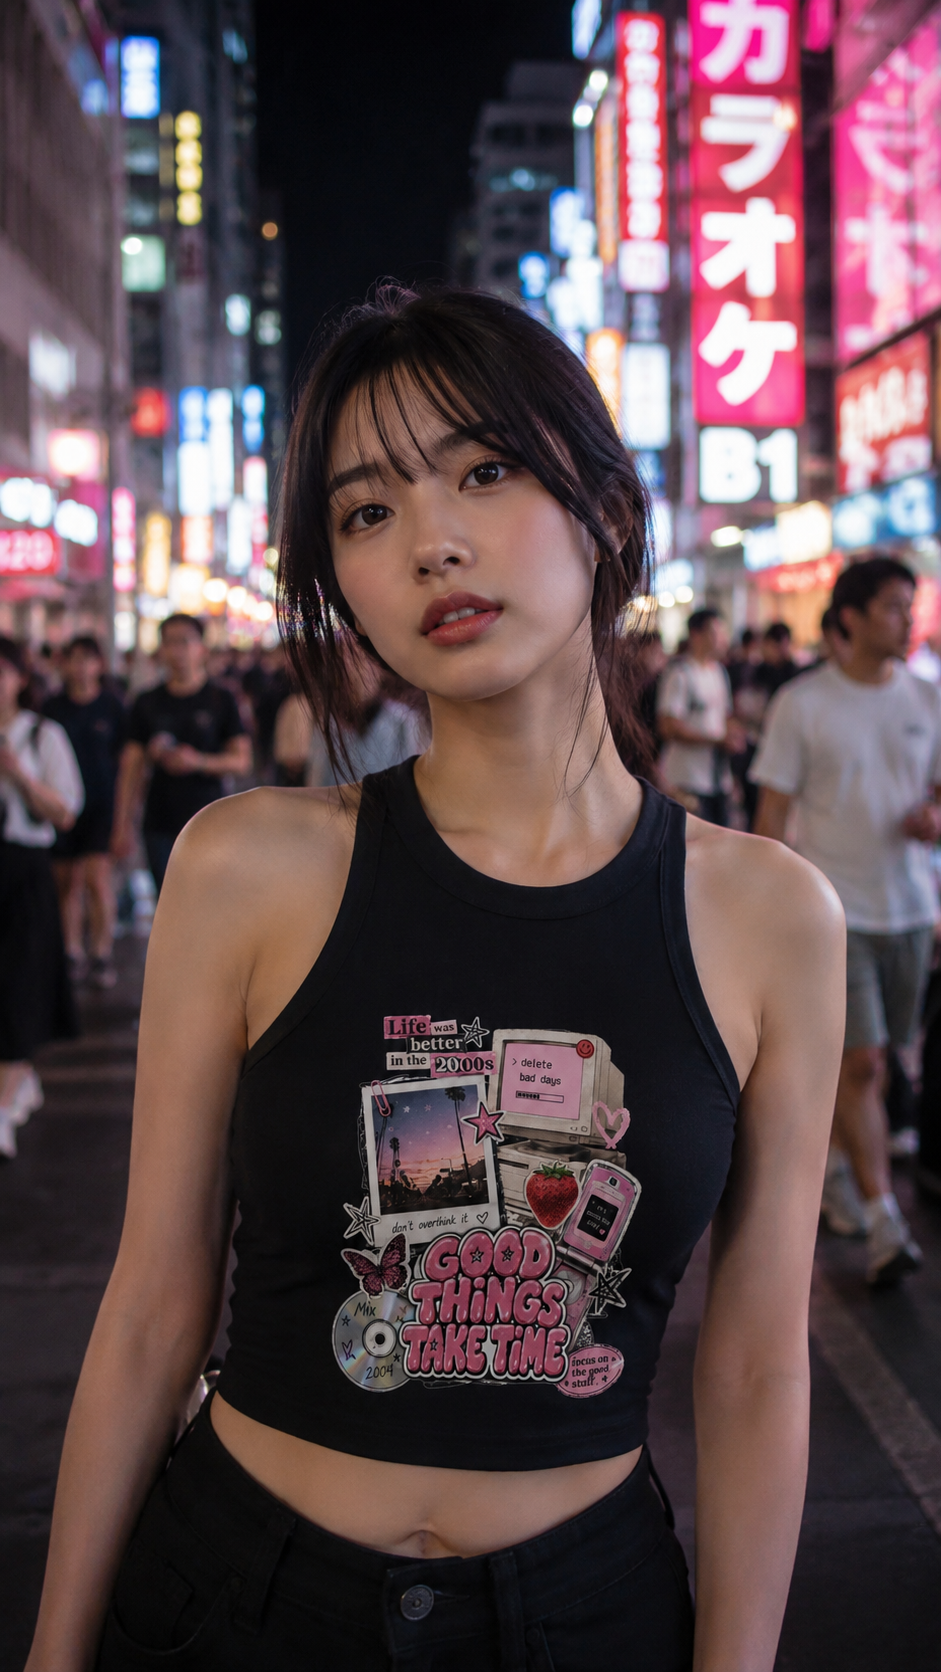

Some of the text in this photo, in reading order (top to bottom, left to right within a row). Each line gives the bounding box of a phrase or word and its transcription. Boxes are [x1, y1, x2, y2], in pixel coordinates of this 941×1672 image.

[699, 0, 798, 406] カラオケ
[699, 427, 798, 503] B1
[388, 1018, 455, 1035] Life was
[410, 1037, 463, 1051] better
[390, 1055, 494, 1073] in the 2000s
[520, 1058, 553, 1069] delete
[519, 1072, 562, 1087] bad days
[392, 1212, 468, 1233] don't overthink it
[422, 1228, 552, 1281] GOOD
[354, 1301, 377, 1317] Mix
[402, 1324, 487, 1374] TAKE
[598, 1355, 609, 1363] on
[365, 1363, 394, 1380] 2004
[572, 1368, 587, 1377] the
